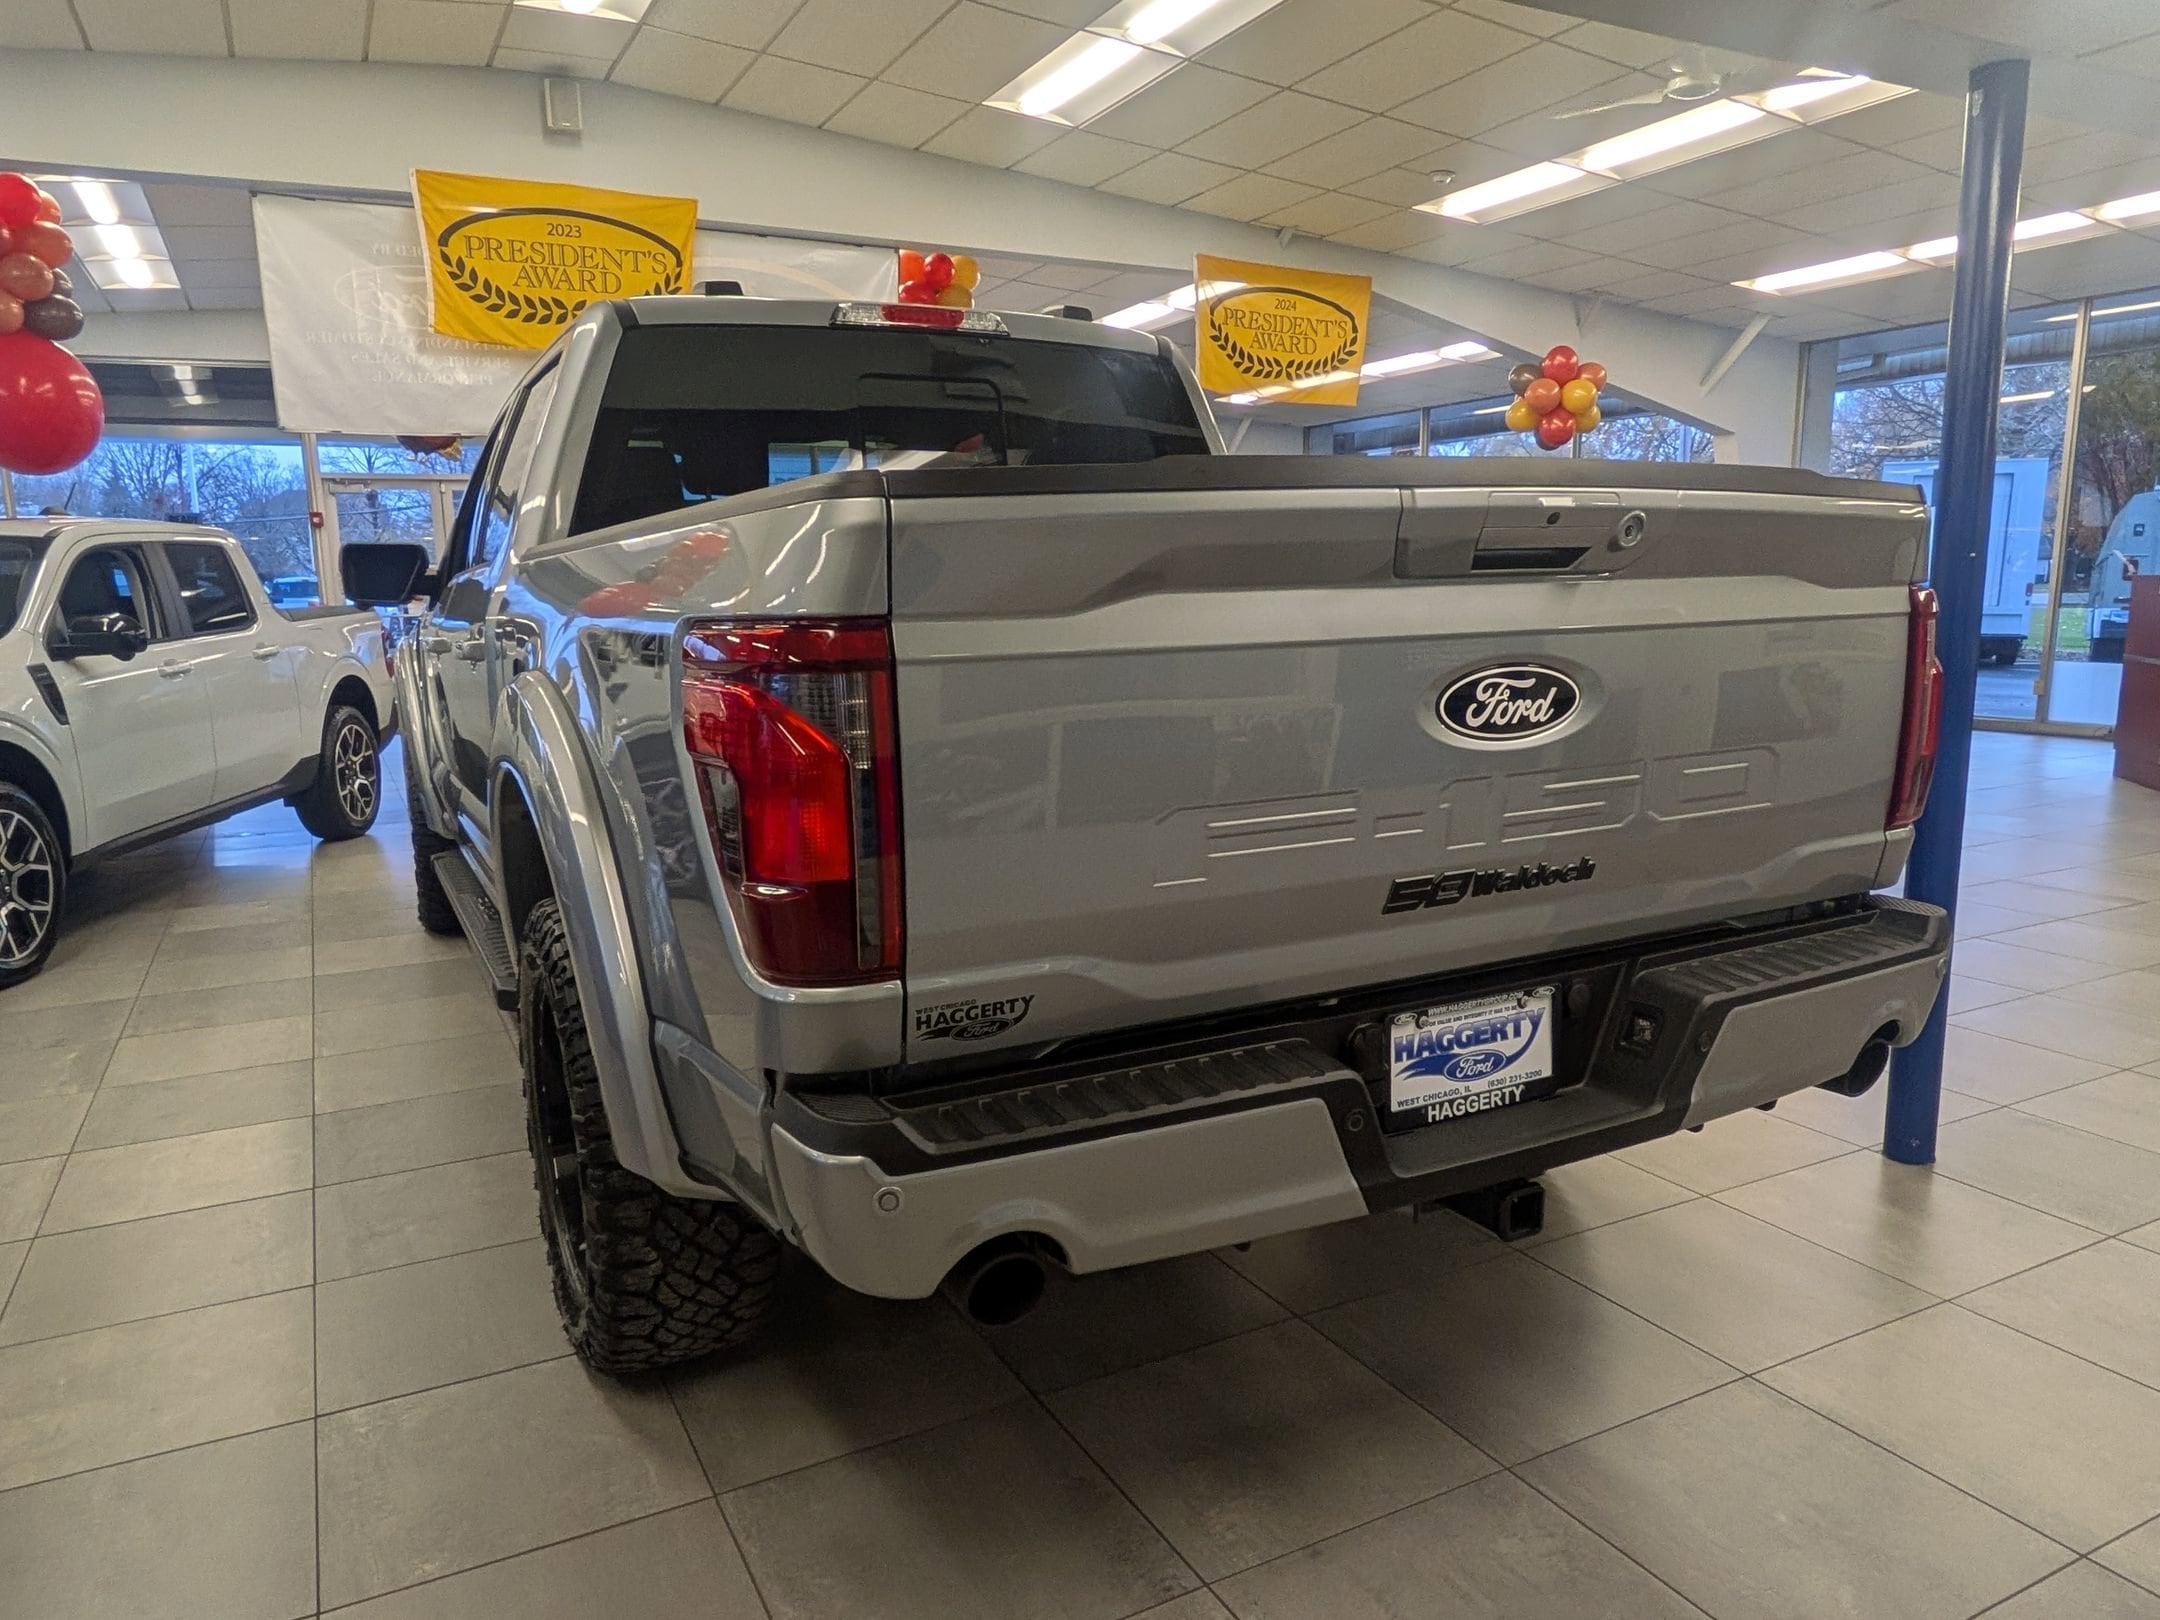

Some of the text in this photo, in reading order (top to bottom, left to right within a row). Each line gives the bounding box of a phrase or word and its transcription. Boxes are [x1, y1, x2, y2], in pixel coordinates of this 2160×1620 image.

[546, 222, 582, 239] 2023
[463, 234, 669, 275] PRESIDENT'S
[511, 264, 622, 295] AWARD
[1274, 298, 1297, 313] 2024
[1222, 306, 1348, 340] PRESIDENT'S
[1248, 333, 1318, 356] AWARD
[1466, 678, 1557, 727] Ford
[1153, 745, 1778, 887] F-150
[915, 994, 1035, 1031] HAGGERTY
[940, 999, 977, 1010] CHICAGO
[1394, 1007, 1546, 1064] HAGGERTY
[1456, 1054, 1495, 1076] Ford
[1487, 1069, 1543, 1089] (630) 231-3200
[1397, 1086, 1472, 1108] WEST CHICAGO, IL
[1428, 1084, 1526, 1123] HAGGERTY
